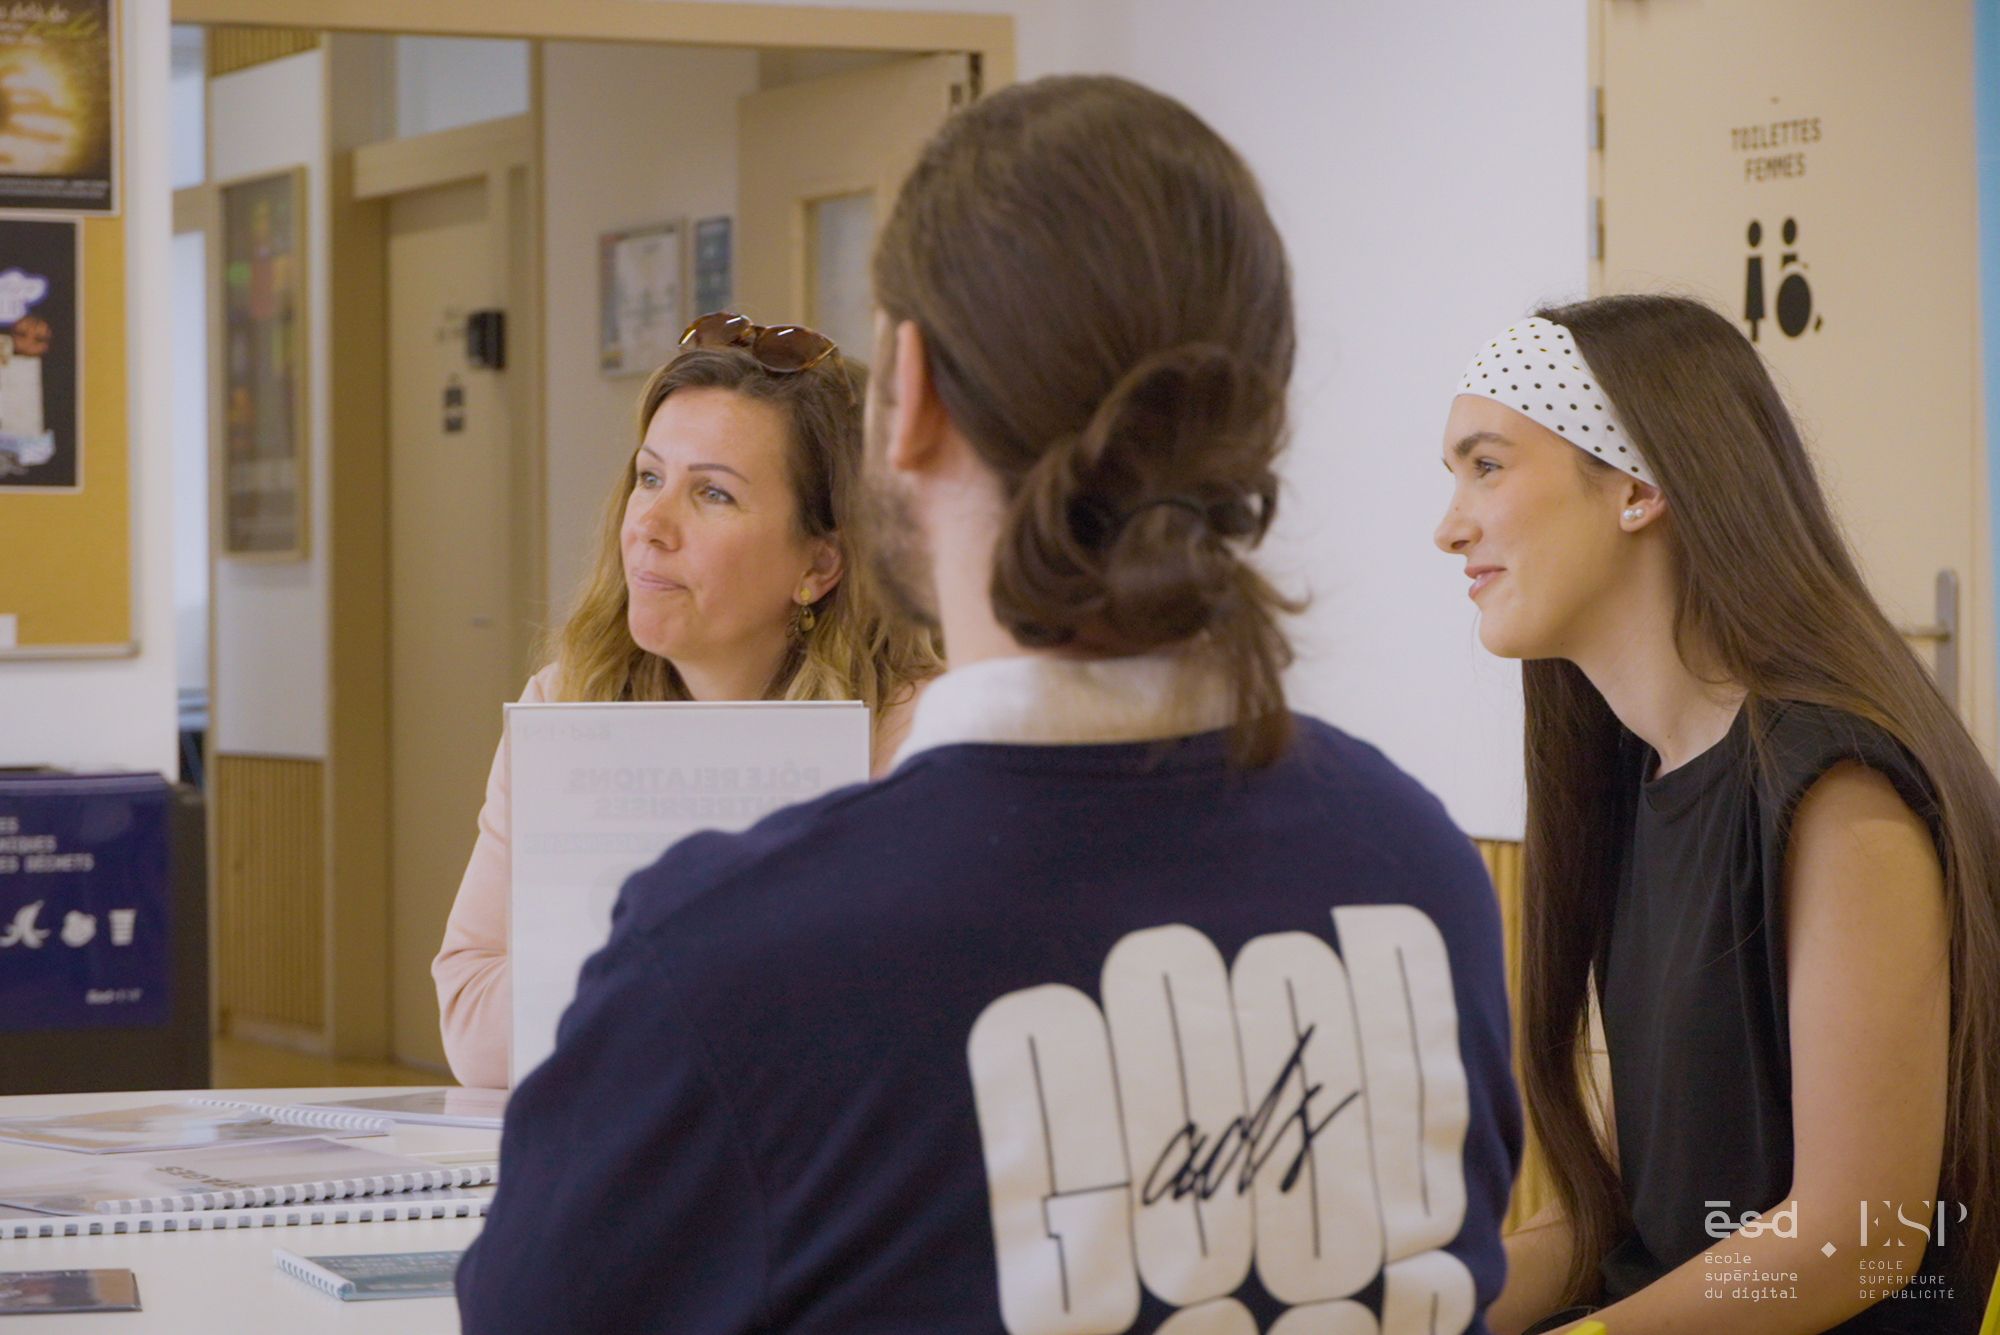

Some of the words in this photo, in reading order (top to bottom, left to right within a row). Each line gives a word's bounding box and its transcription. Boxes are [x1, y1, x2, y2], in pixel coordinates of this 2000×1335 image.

[1730, 117, 1822, 151] TOILETTES
[1745, 153, 1806, 182] FEMMES
[966, 903, 1470, 1335] GOOD
